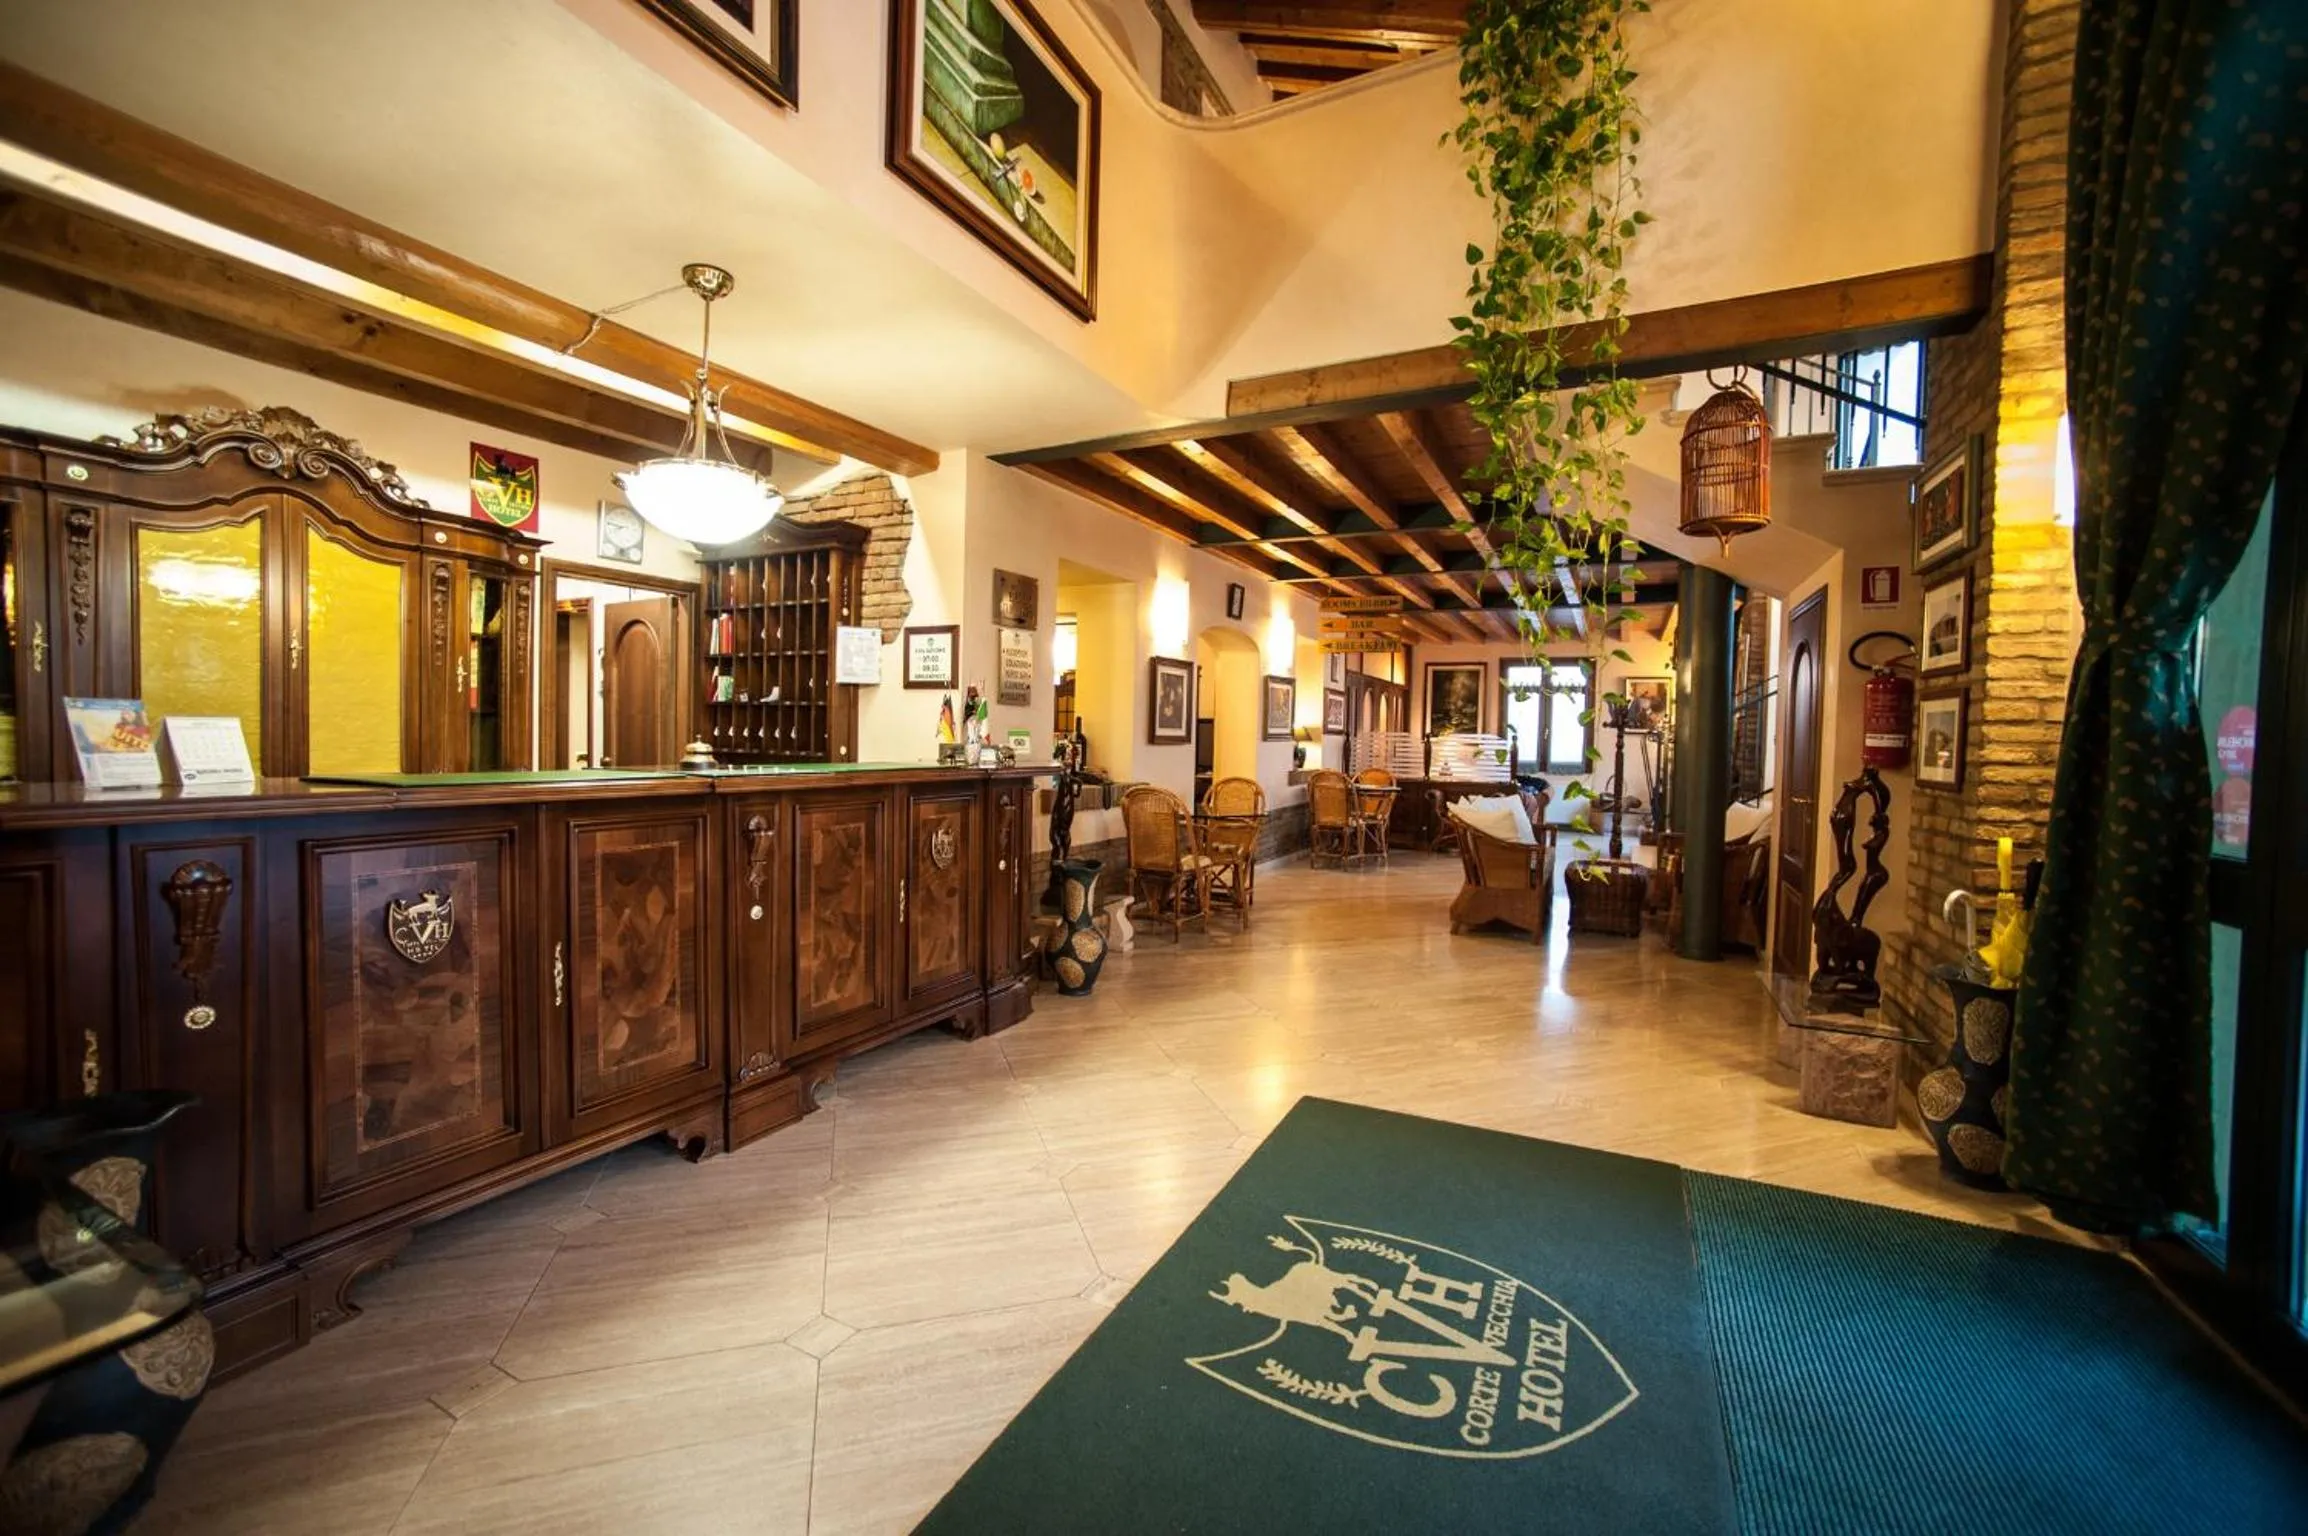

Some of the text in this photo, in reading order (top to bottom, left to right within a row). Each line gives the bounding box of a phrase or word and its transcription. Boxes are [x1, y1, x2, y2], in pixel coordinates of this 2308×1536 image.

[1459, 1278, 1519, 1446] CORTE VECCHIA
[1517, 1317, 1569, 1432] HOTEL
